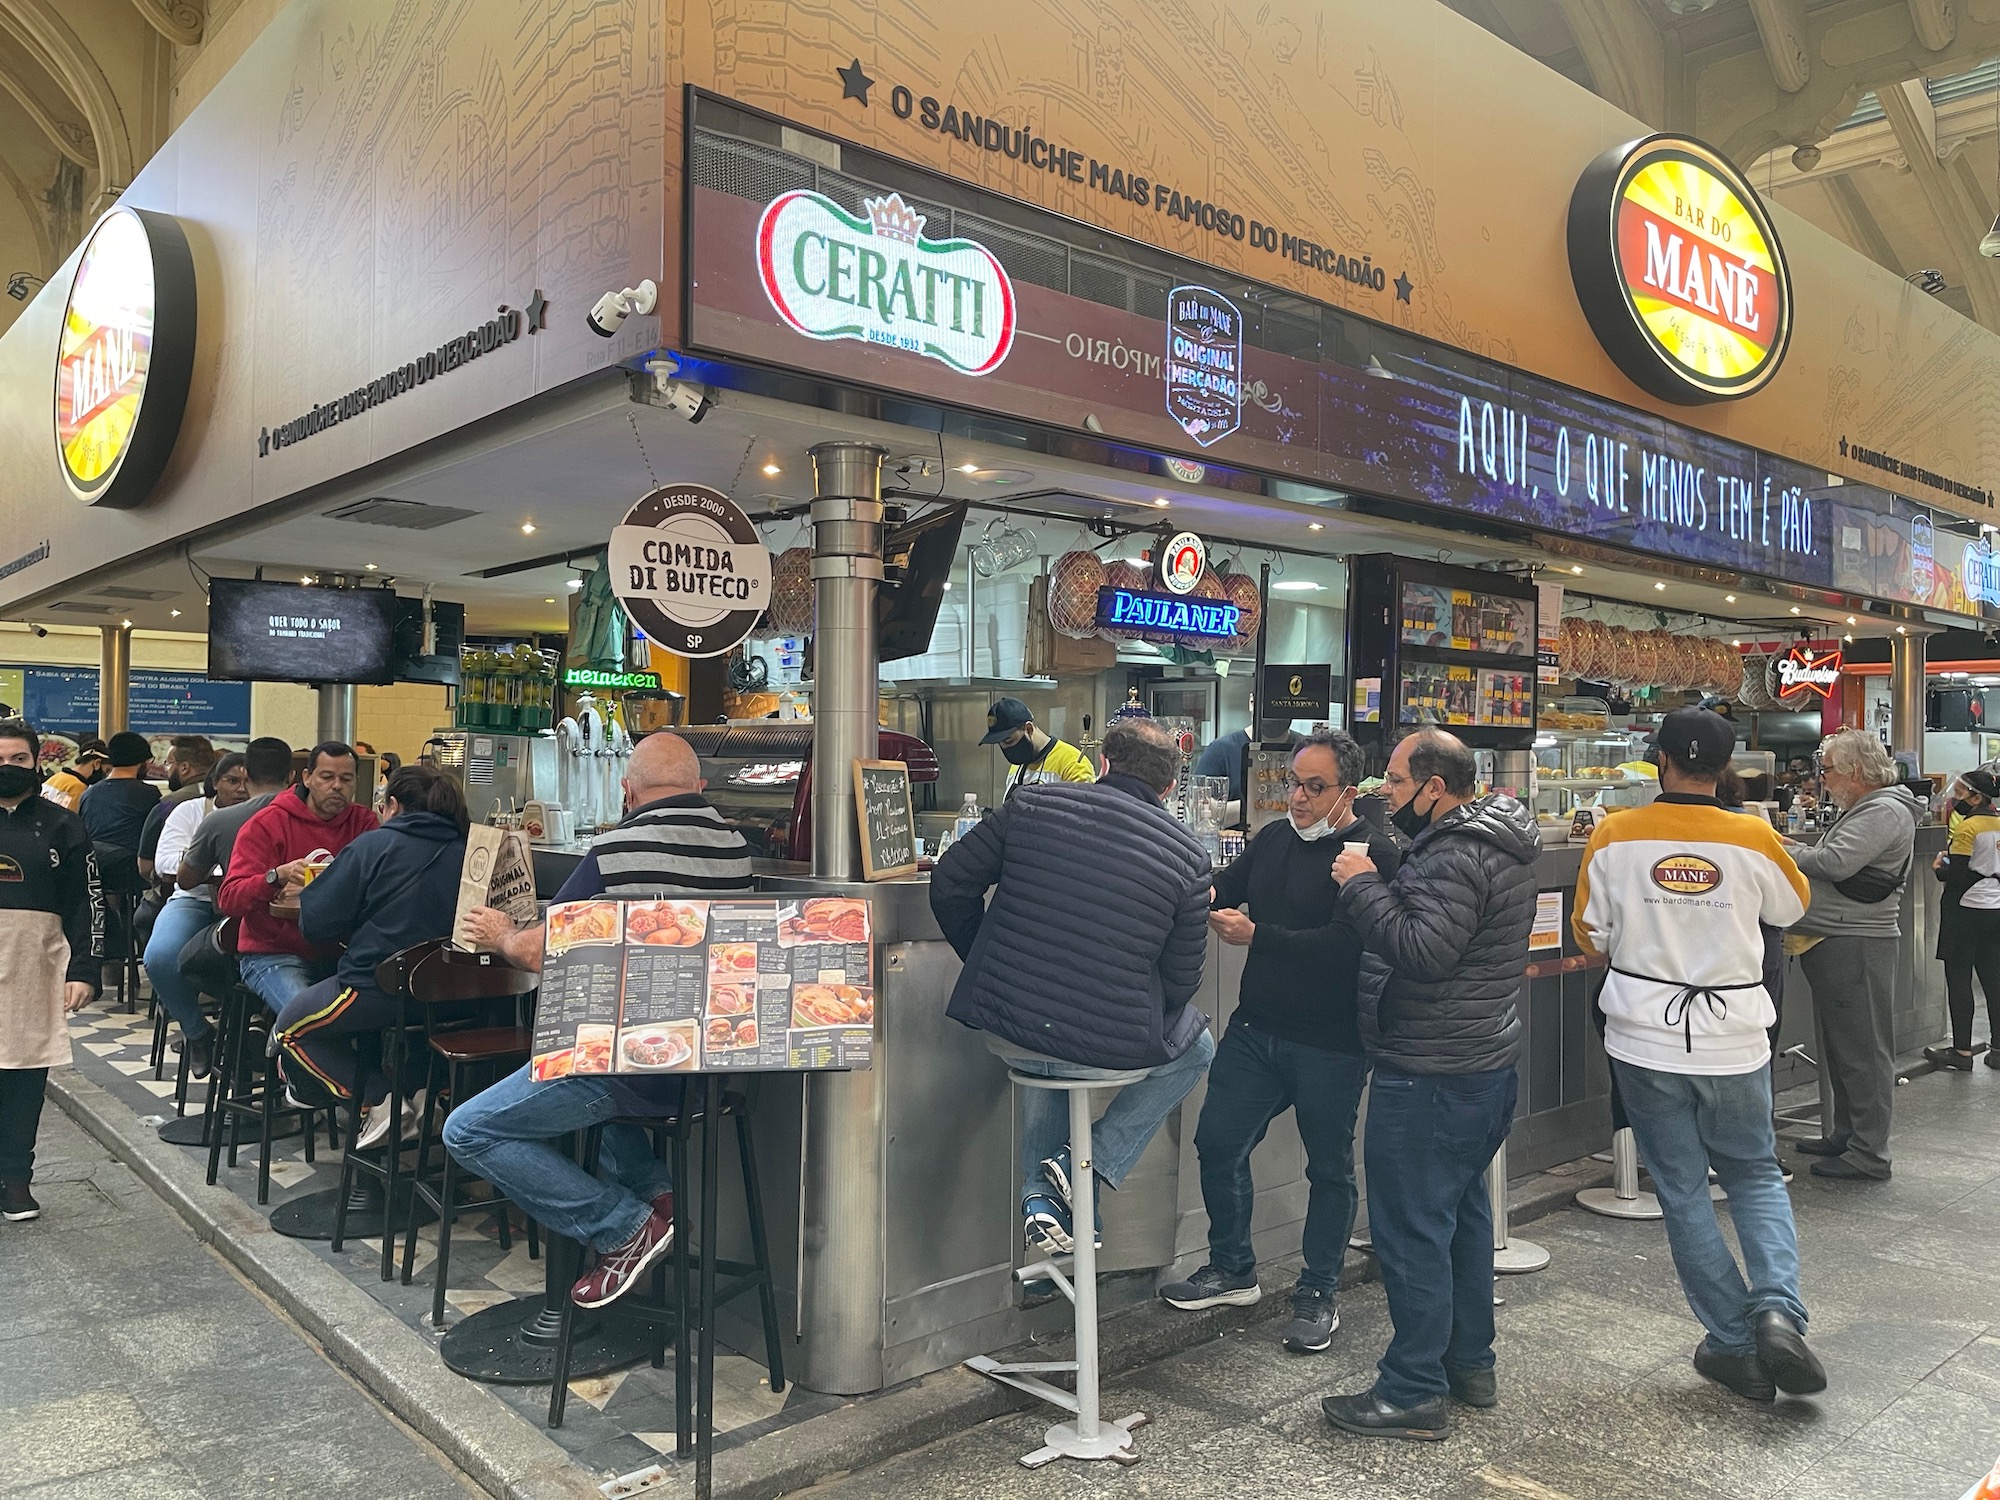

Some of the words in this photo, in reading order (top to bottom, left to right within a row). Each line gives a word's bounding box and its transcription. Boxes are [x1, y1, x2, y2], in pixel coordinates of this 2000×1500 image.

[891, 84, 912, 120] O
[920, 96, 1084, 185] SANDUÍCHE
[1089, 156, 1150, 208] MAIS
[1155, 183, 1246, 241] FAMOSO
[1250, 219, 1278, 253] DO
[1281, 235, 1386, 293] MERCADÃO
[1675, 195, 1705, 230] BAR
[1711, 215, 1732, 243] DO
[792, 229, 987, 341] CERATTI
[1642, 220, 1760, 333] MANÉ
[1178, 299, 1199, 321] BAR
[869, 327, 897, 346] DESDE
[1173, 335, 1235, 372] ORIGINAL
[272, 427, 280, 451] O
[280, 401, 338, 448] SANDUÍCHE
[338, 387, 367, 423] MAIS
[366, 362, 416, 410] FAMOSO
[416, 351, 437, 386] DO
[436, 304, 521, 376] MERCADÃO
[1171, 364, 1236, 398] MERCADÃO
[1851, 444, 1858, 460] O
[1457, 397, 1540, 499] AQUI,
[1556, 426, 1570, 498] O
[1585, 433, 1631, 515] QUE
[1642, 452, 1707, 533] MENOS
[1717, 475, 1755, 543] TEM
[1763, 476, 1773, 547] É
[1781, 486, 1818, 557] PÃO.
[662, 493, 698, 510] DESDE
[700, 496, 726, 518] 2000
[642, 540, 734, 574] COMIDA
[629, 565, 658, 591] DI
[268, 614, 288, 630] QUER
[290, 616, 308, 630] TODO
[310, 618, 316, 630] O
[318, 617, 342, 632] SABOR
[1109, 590, 1241, 637] PAULANER
[686, 634, 703, 649] SP
[35, 670, 60, 678] SABIA
[564, 668, 658, 689] Heineken
[1777, 658, 1840, 687] Budweiser
[490, 865, 525, 891] ORIGINAL
[1664, 867, 1709, 883] MANÉ
[490, 881, 531, 909] MERCADÃO
